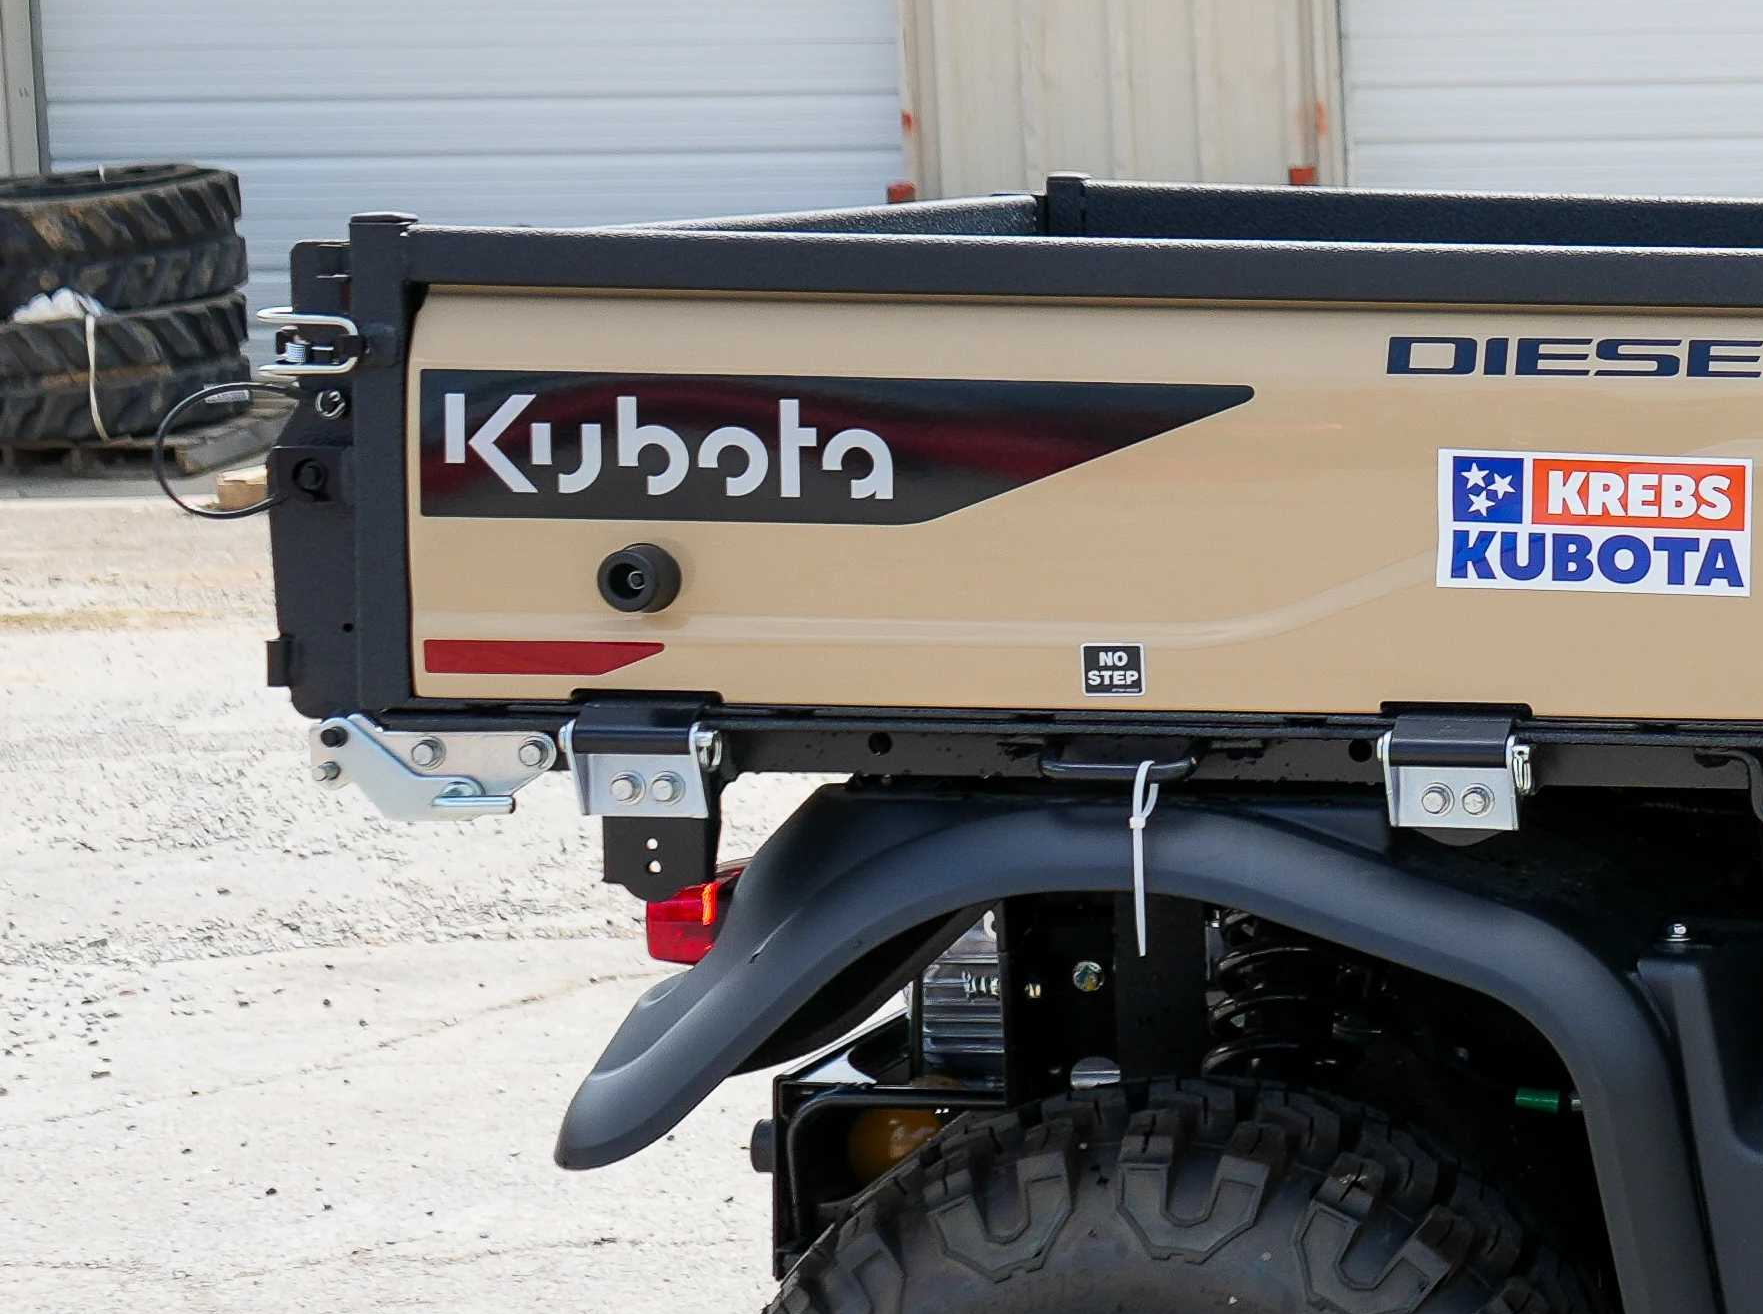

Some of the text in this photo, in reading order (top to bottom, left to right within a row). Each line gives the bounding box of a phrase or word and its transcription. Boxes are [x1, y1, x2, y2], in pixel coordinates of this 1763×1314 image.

[444, 392, 894, 501] Kubota
[1547, 469, 1732, 520] KREBS
[1450, 529, 1745, 588] KUBOTA
[1087, 670, 1139, 686] STEP
[1098, 651, 1128, 667] NO
